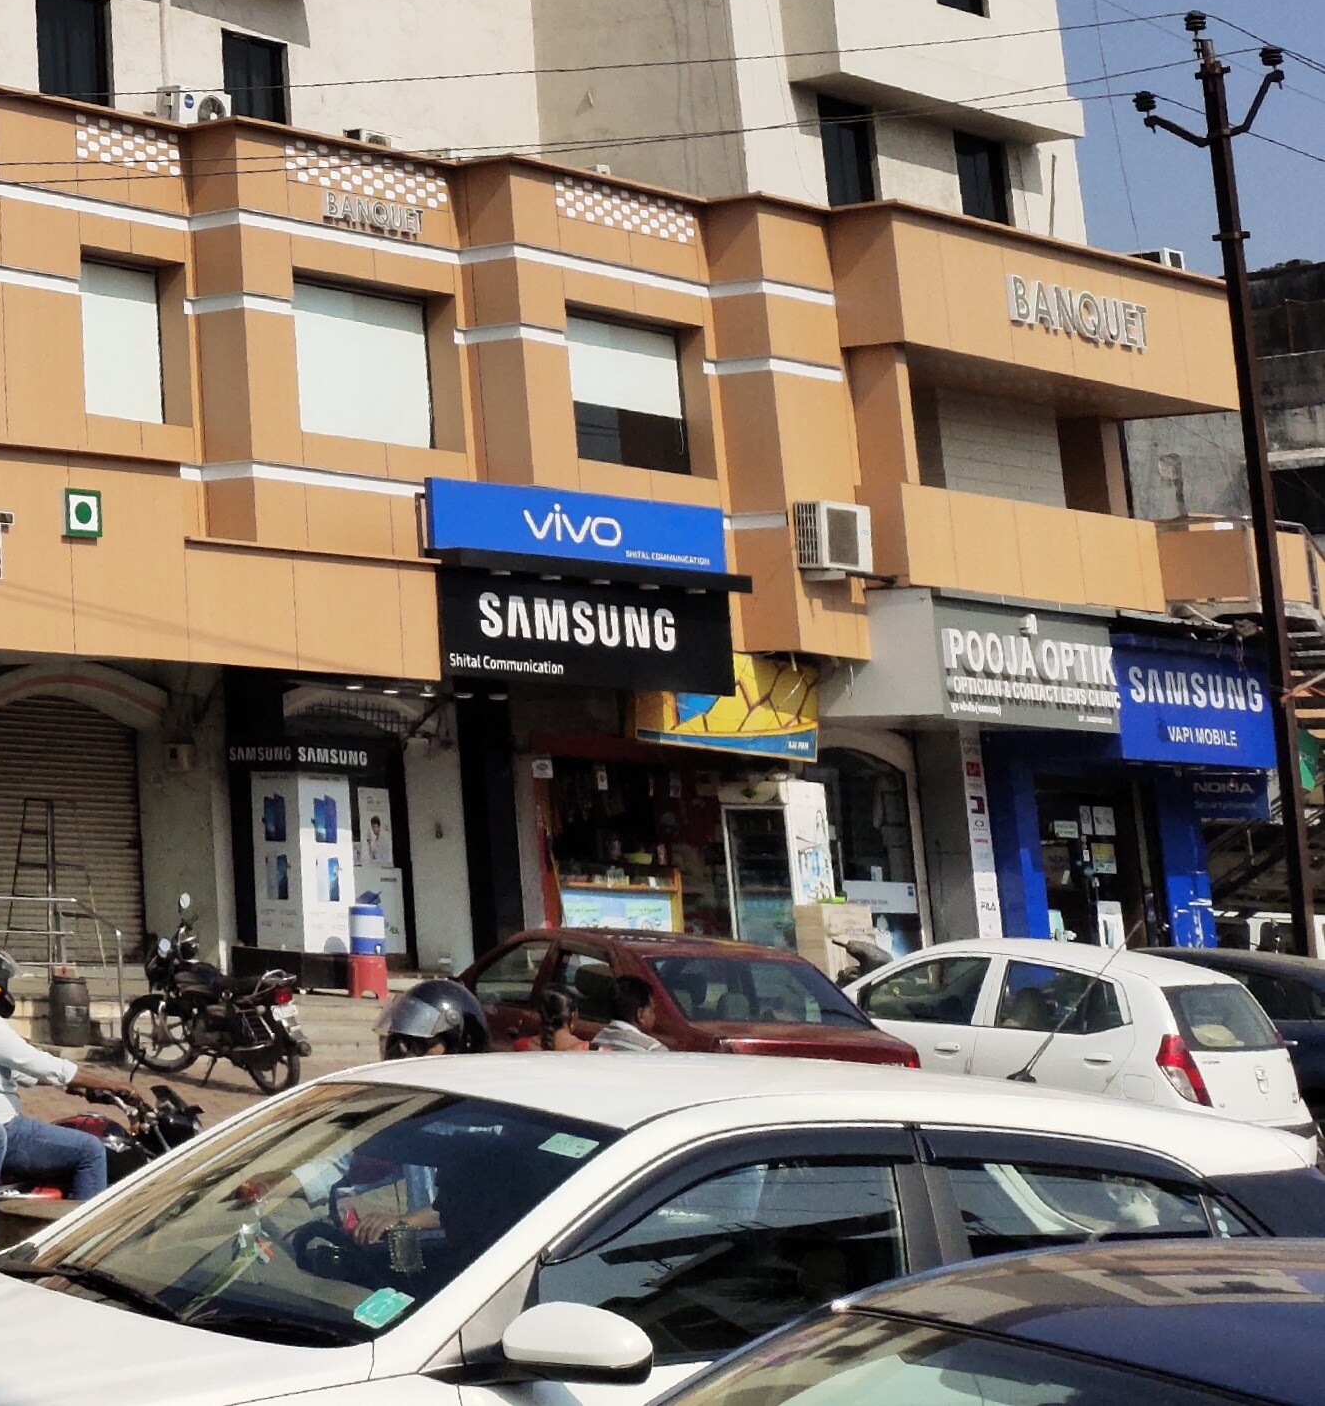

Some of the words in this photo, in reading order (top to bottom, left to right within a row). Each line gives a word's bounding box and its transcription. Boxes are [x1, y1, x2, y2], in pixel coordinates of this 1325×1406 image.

[323, 191, 424, 235] BANQUET
[1006, 274, 1148, 349] BANQUET
[523, 502, 622, 547] vivo
[625, 550, 649, 561] SHITAL
[650, 552, 711, 567] COMMUNICATION
[478, 591, 677, 652] SAMSUNG
[449, 652, 482, 670] Shital
[482, 655, 564, 676] Communication
[941, 628, 1038, 678] POOJA
[1037, 639, 1118, 687] OPTIK
[953, 676, 1002, 696] OPTICIAN
[1012, 681, 1057, 703] CONTACT
[1060, 686, 1087, 706] LENS
[1088, 690, 1122, 710] CLINIC
[1128, 666, 1264, 712] SAMSUNG
[1166, 725, 1194, 743] VAPI
[1196, 727, 1238, 747] MOBILE
[229, 746, 292, 762] SAMSUNG
[298, 747, 369, 766] SAMSUNG
[1193, 782, 1255, 795] NOKIA
[980, 902, 996, 911] FILA
